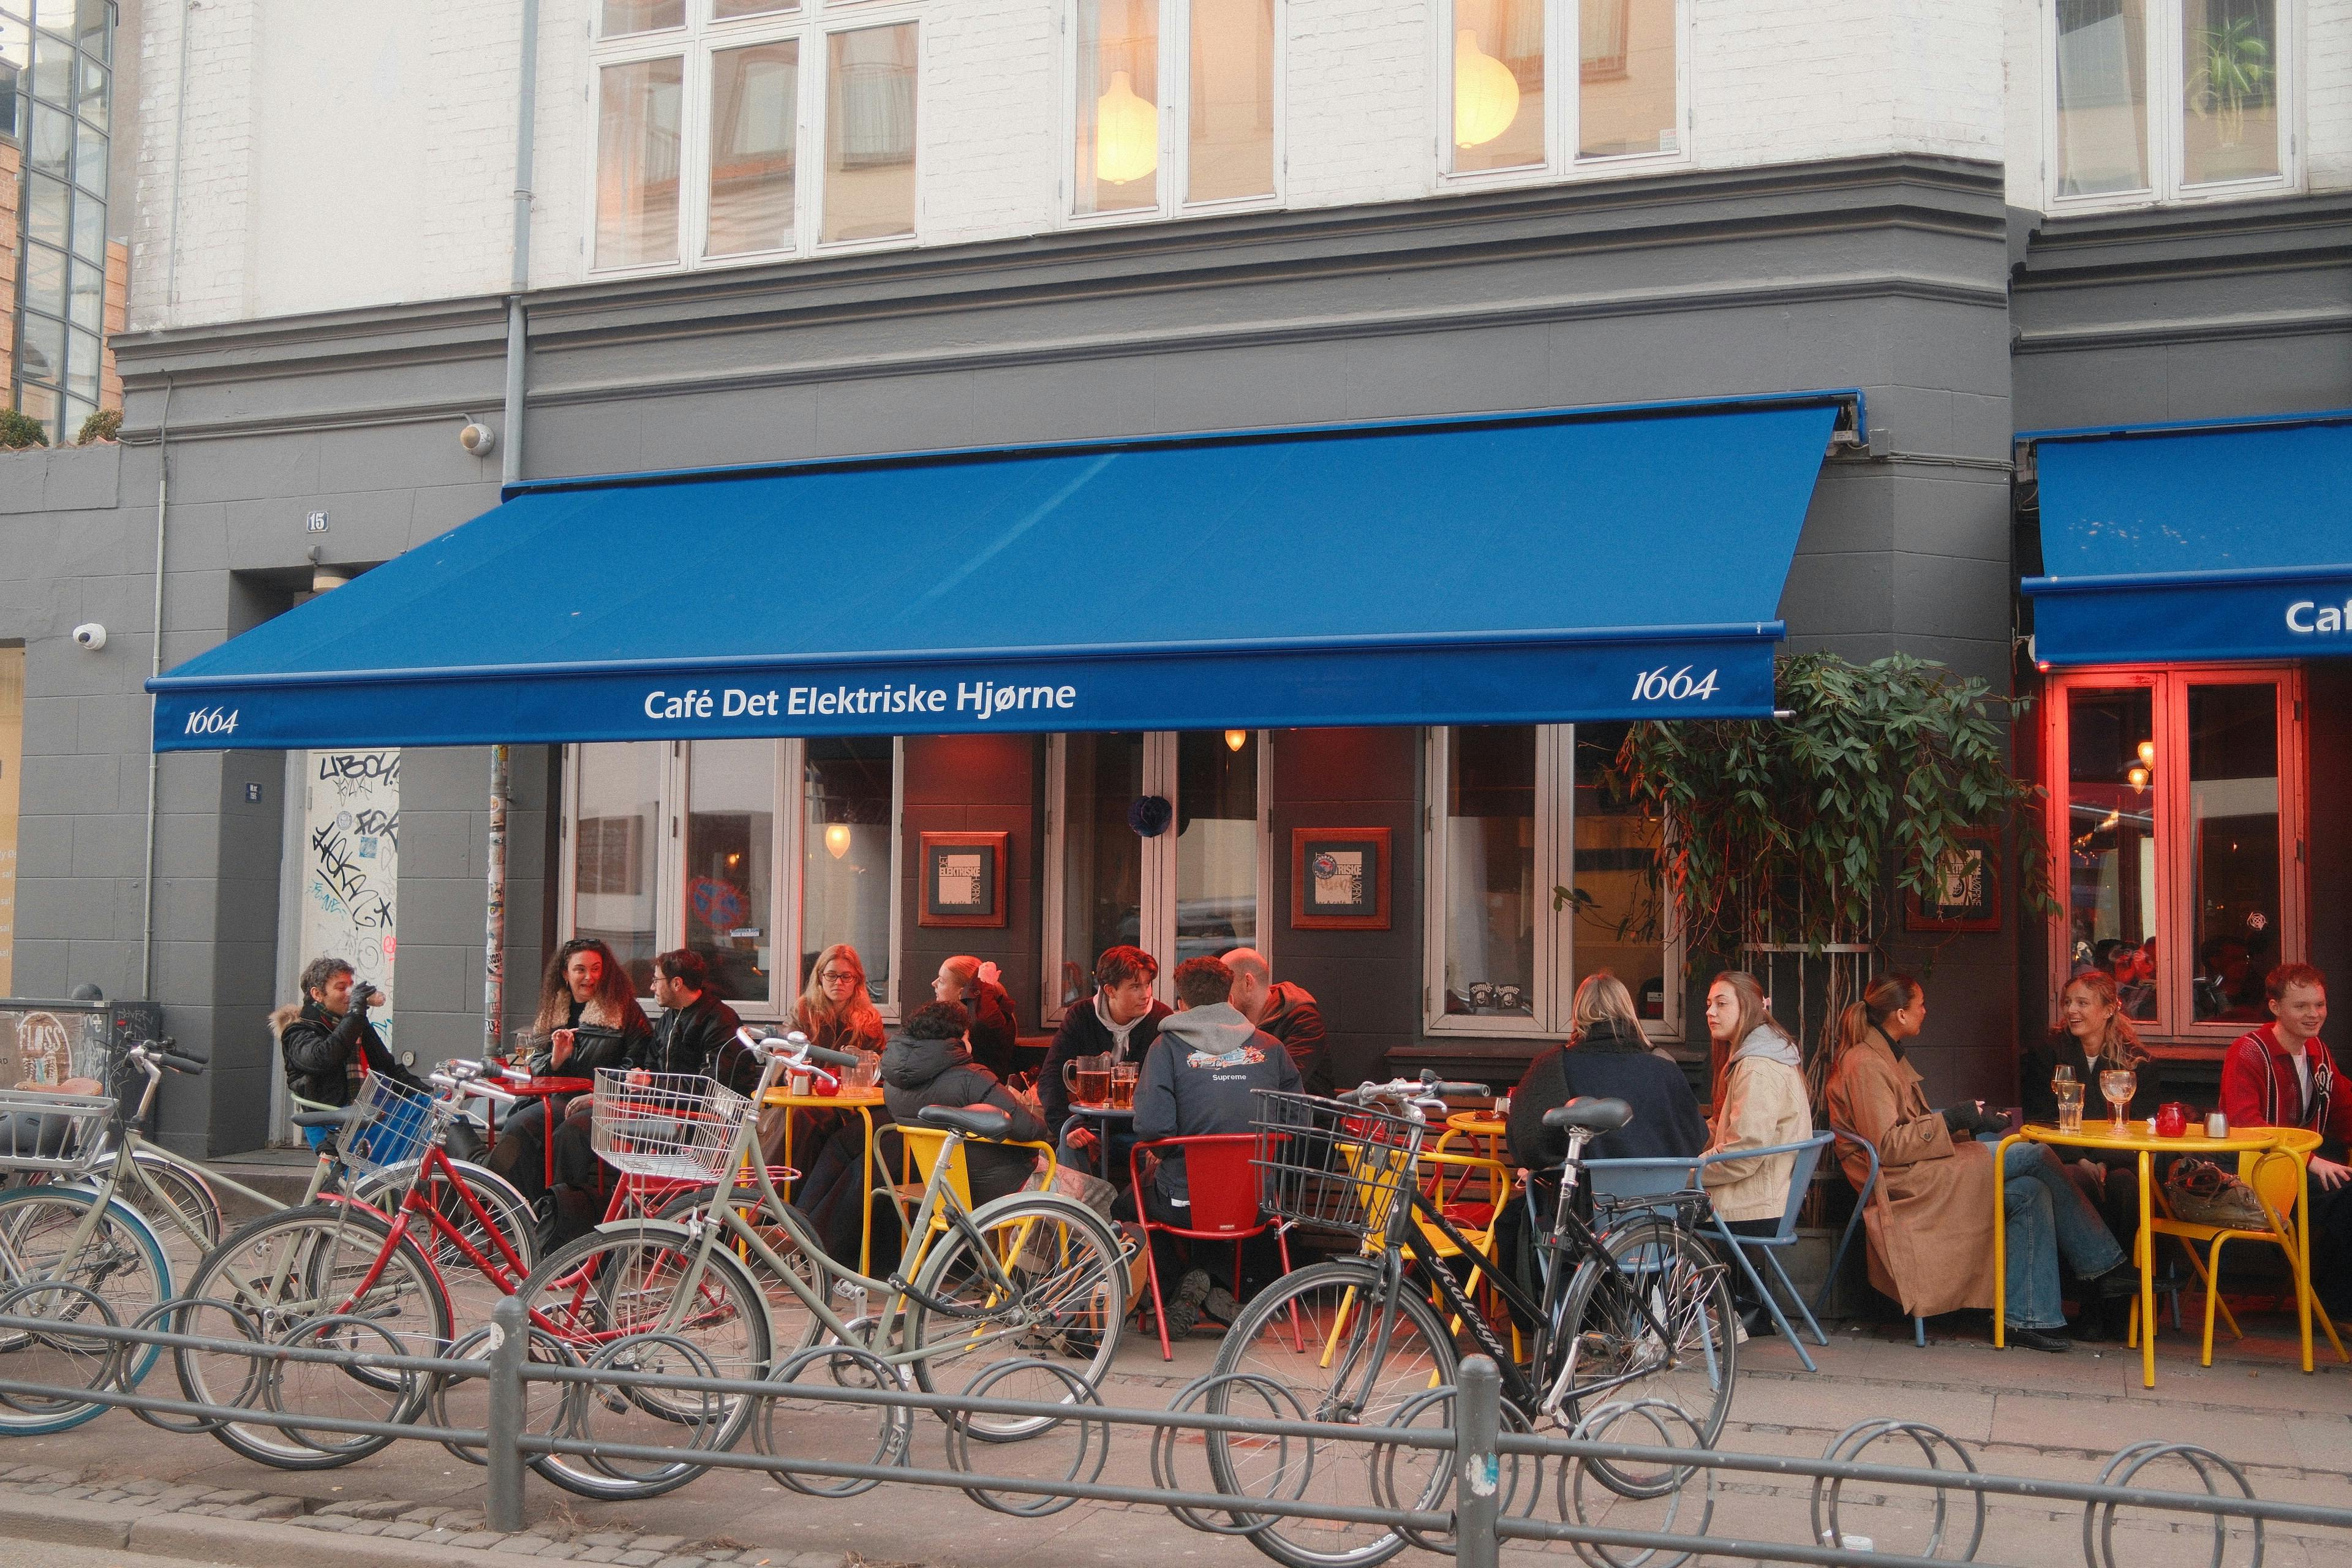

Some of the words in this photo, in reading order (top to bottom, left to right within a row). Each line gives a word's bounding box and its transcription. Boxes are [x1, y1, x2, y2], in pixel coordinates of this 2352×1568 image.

[310, 512, 325, 530] 15
[1632, 665, 1720, 700] 1664
[644, 690, 714, 718] Café
[722, 689, 779, 717] Det
[788, 682, 947, 715] Elektriske
[957, 681, 1076, 720] Hjørne
[184, 706, 239, 734] 1664
[1352, 874, 1362, 905] HJØRNE
[1428, 1256, 1505, 1358] Raleigh
